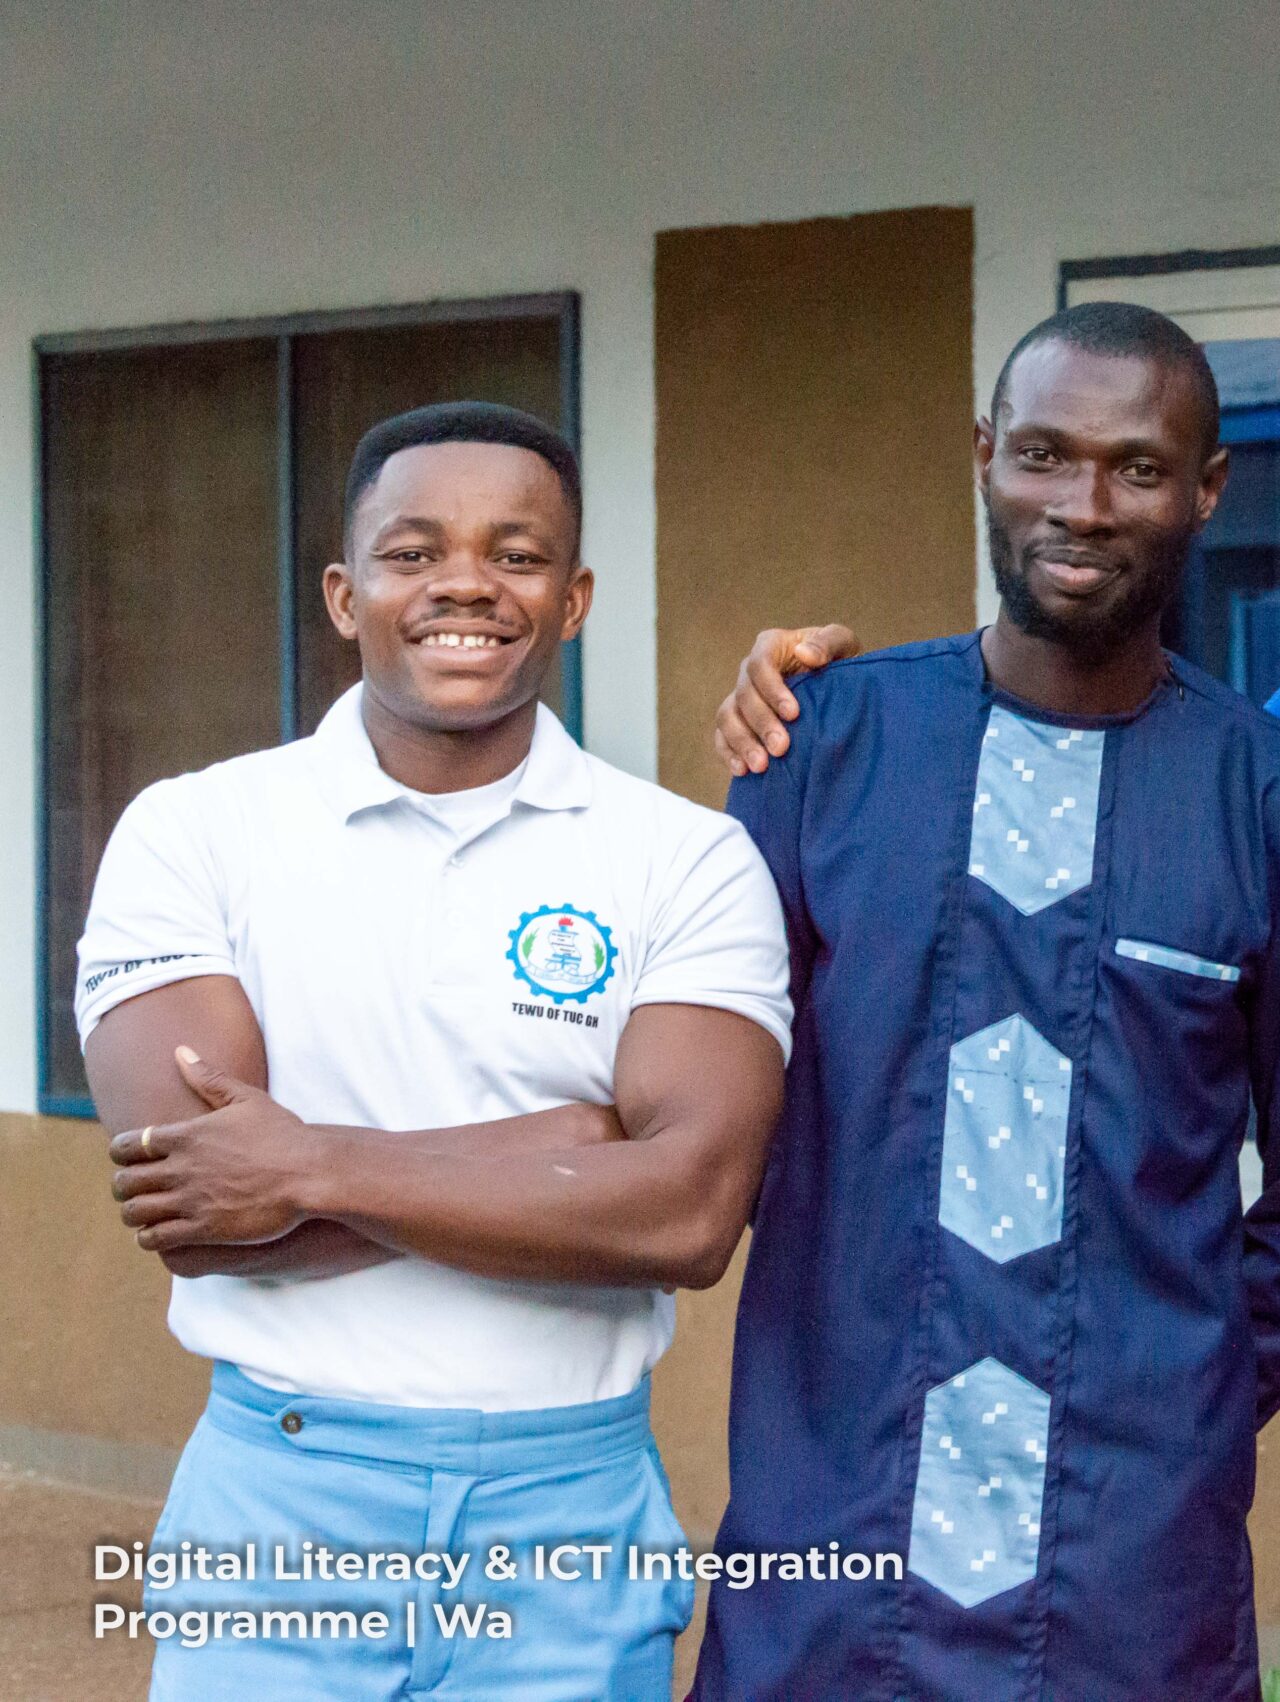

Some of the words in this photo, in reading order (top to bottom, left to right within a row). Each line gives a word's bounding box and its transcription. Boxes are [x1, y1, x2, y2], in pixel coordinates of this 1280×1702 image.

[512, 1002, 544, 1018] TEWU
[546, 1007, 561, 1021] OF
[562, 1009, 584, 1025] TUC
[585, 1014, 599, 1028] GH
